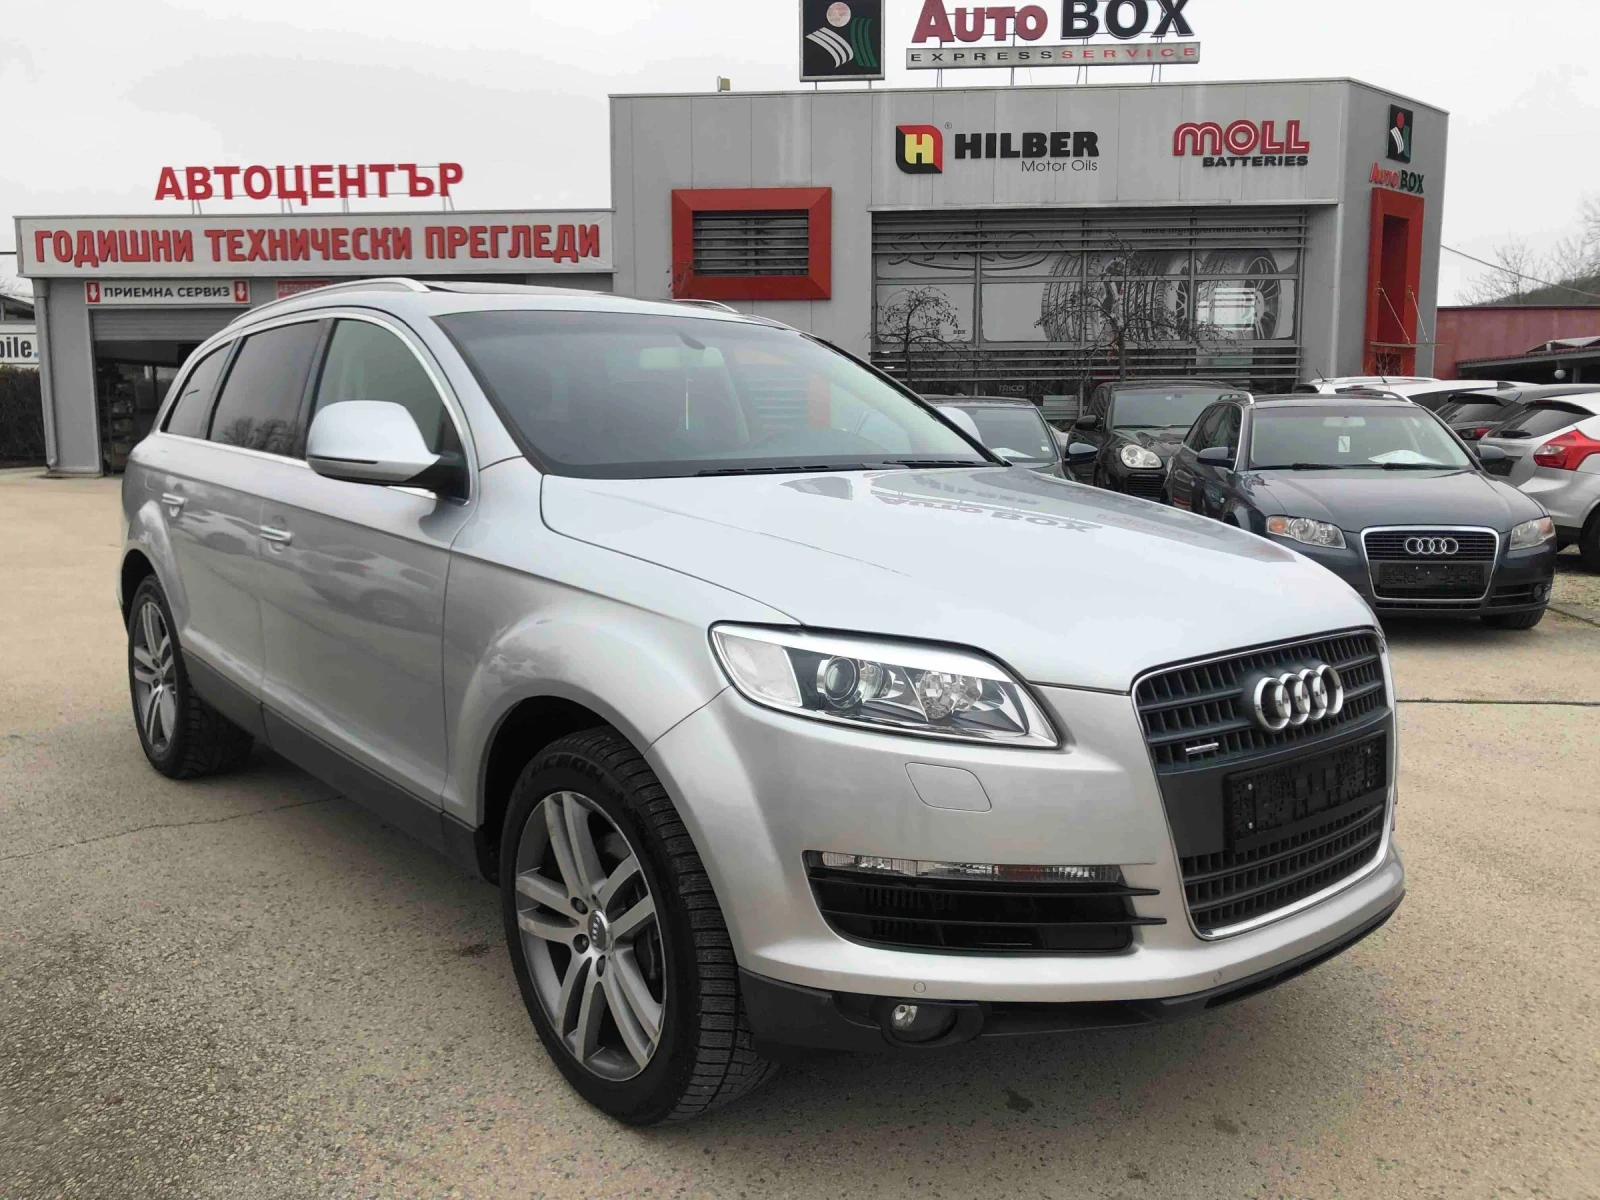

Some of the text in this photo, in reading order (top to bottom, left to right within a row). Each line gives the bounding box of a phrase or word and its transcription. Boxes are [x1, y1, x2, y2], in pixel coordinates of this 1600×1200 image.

[1060, 0, 1195, 39] BOX
[954, 131, 1099, 159] HILBER
[1021, 157, 1098, 172] Motor Oils
[1202, 155, 1309, 167] BATTERIES
[155, 162, 464, 205] АВТОЦЕНТЪР
[1400, 169, 1425, 194] BOX
[35, 224, 600, 266] ГОДИШНИ ТЕХНИЧЕСКИ ПРЕГЛЕДИ
[104, 286, 230, 298] ПРИЕМНА СЕРВИЗ
